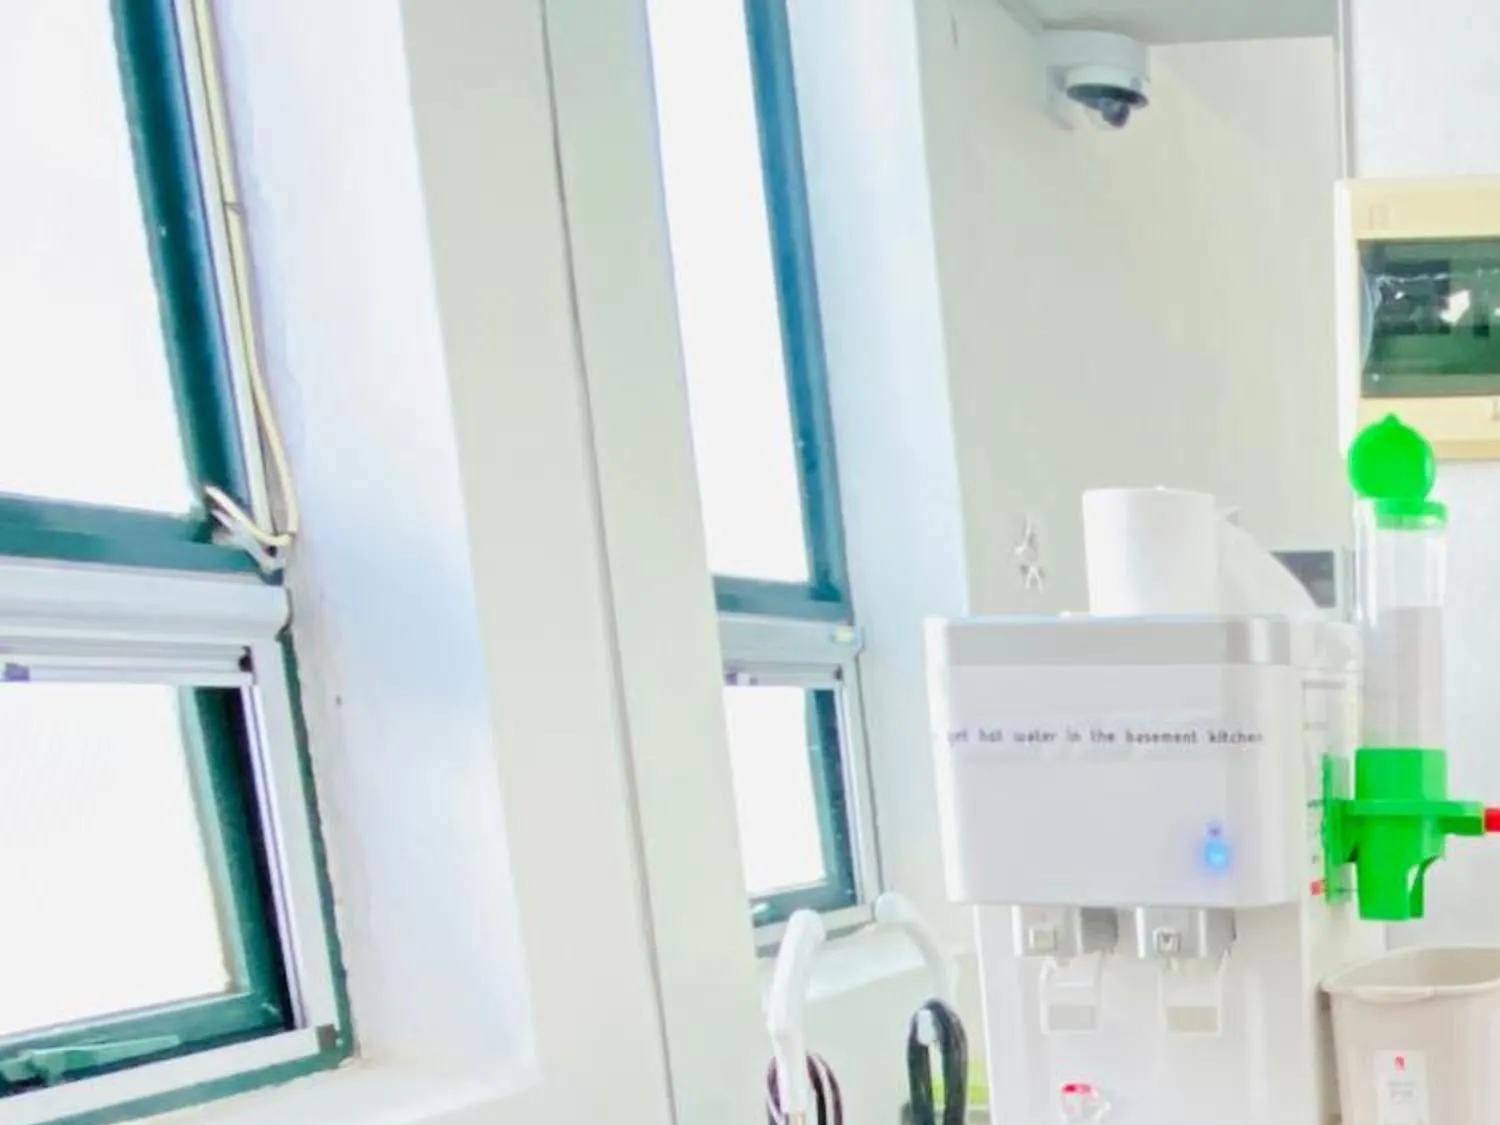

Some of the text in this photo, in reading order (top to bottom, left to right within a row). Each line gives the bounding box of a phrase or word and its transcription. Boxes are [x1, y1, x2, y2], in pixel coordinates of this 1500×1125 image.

[1013, 729, 1057, 743] water
[1090, 728, 1116, 743] the
[1125, 729, 1198, 744] basement
[1208, 730, 1264, 744] kitchen
